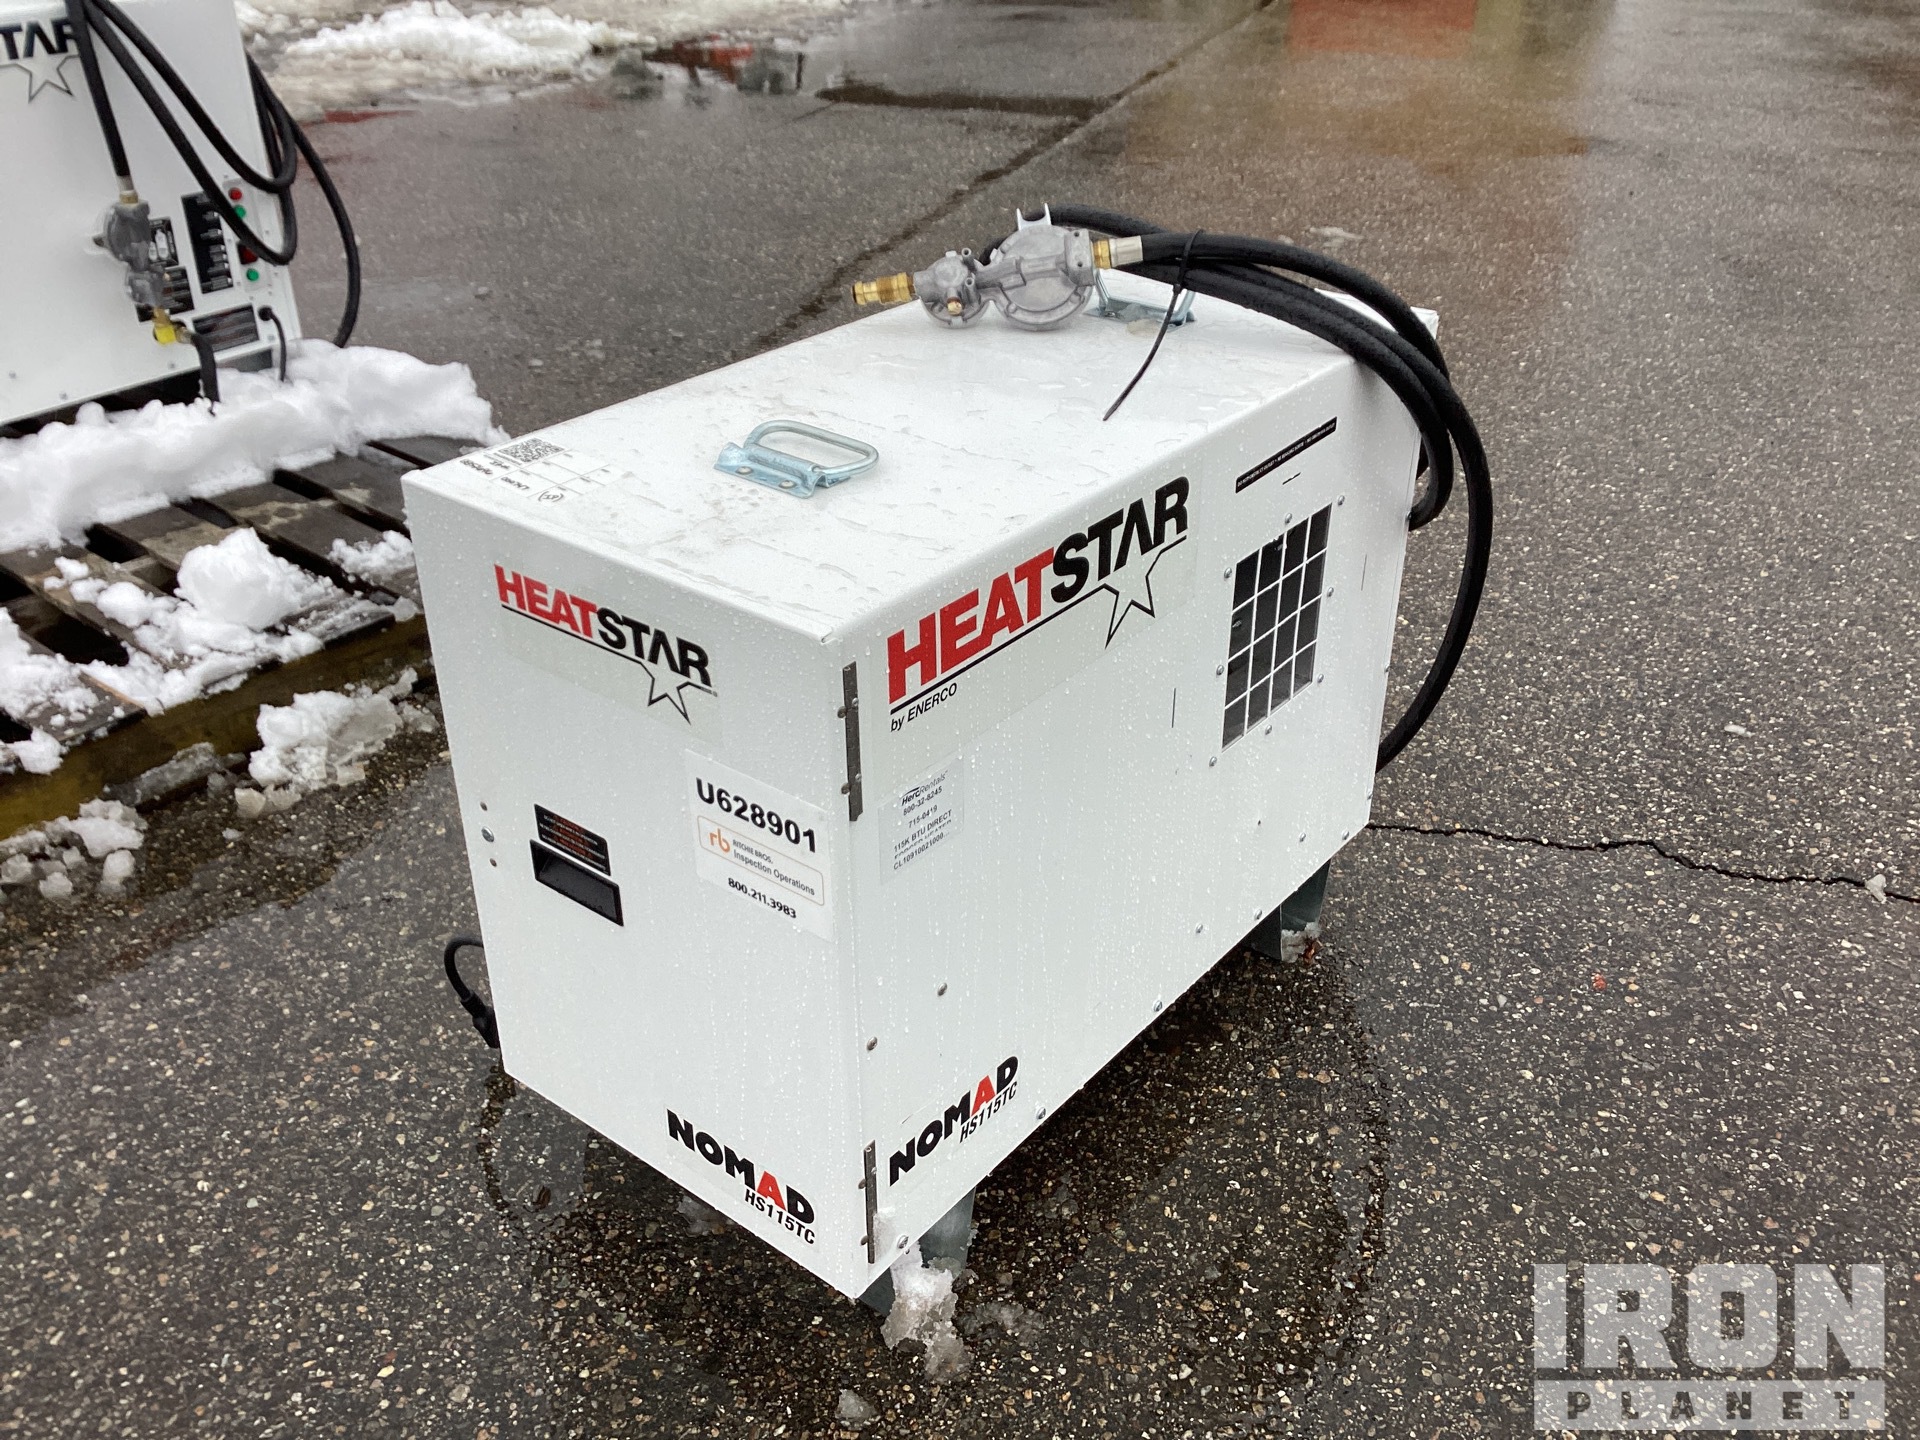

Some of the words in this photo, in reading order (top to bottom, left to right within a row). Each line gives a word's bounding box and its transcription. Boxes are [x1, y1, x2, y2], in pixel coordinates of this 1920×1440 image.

[887, 476, 1190, 704] HEATSTAR
[493, 563, 712, 687] HEATSTAR
[890, 716, 905, 732] by
[907, 682, 957, 722] ENERCO
[696, 777, 816, 853] U628901
[894, 837, 910, 852] 115K
[911, 826, 925, 841] BTU
[733, 839, 754, 855] RITCHIE
[733, 849, 772, 875] Inspection
[773, 869, 815, 896] Operations
[728, 877, 797, 919] 800.211.3983
[889, 1056, 1019, 1187] NOMAD
[959, 1080, 1018, 1144] HS115TC
[666, 1108, 815, 1224] NOMAD
[744, 1188, 815, 1245] HS115TC
